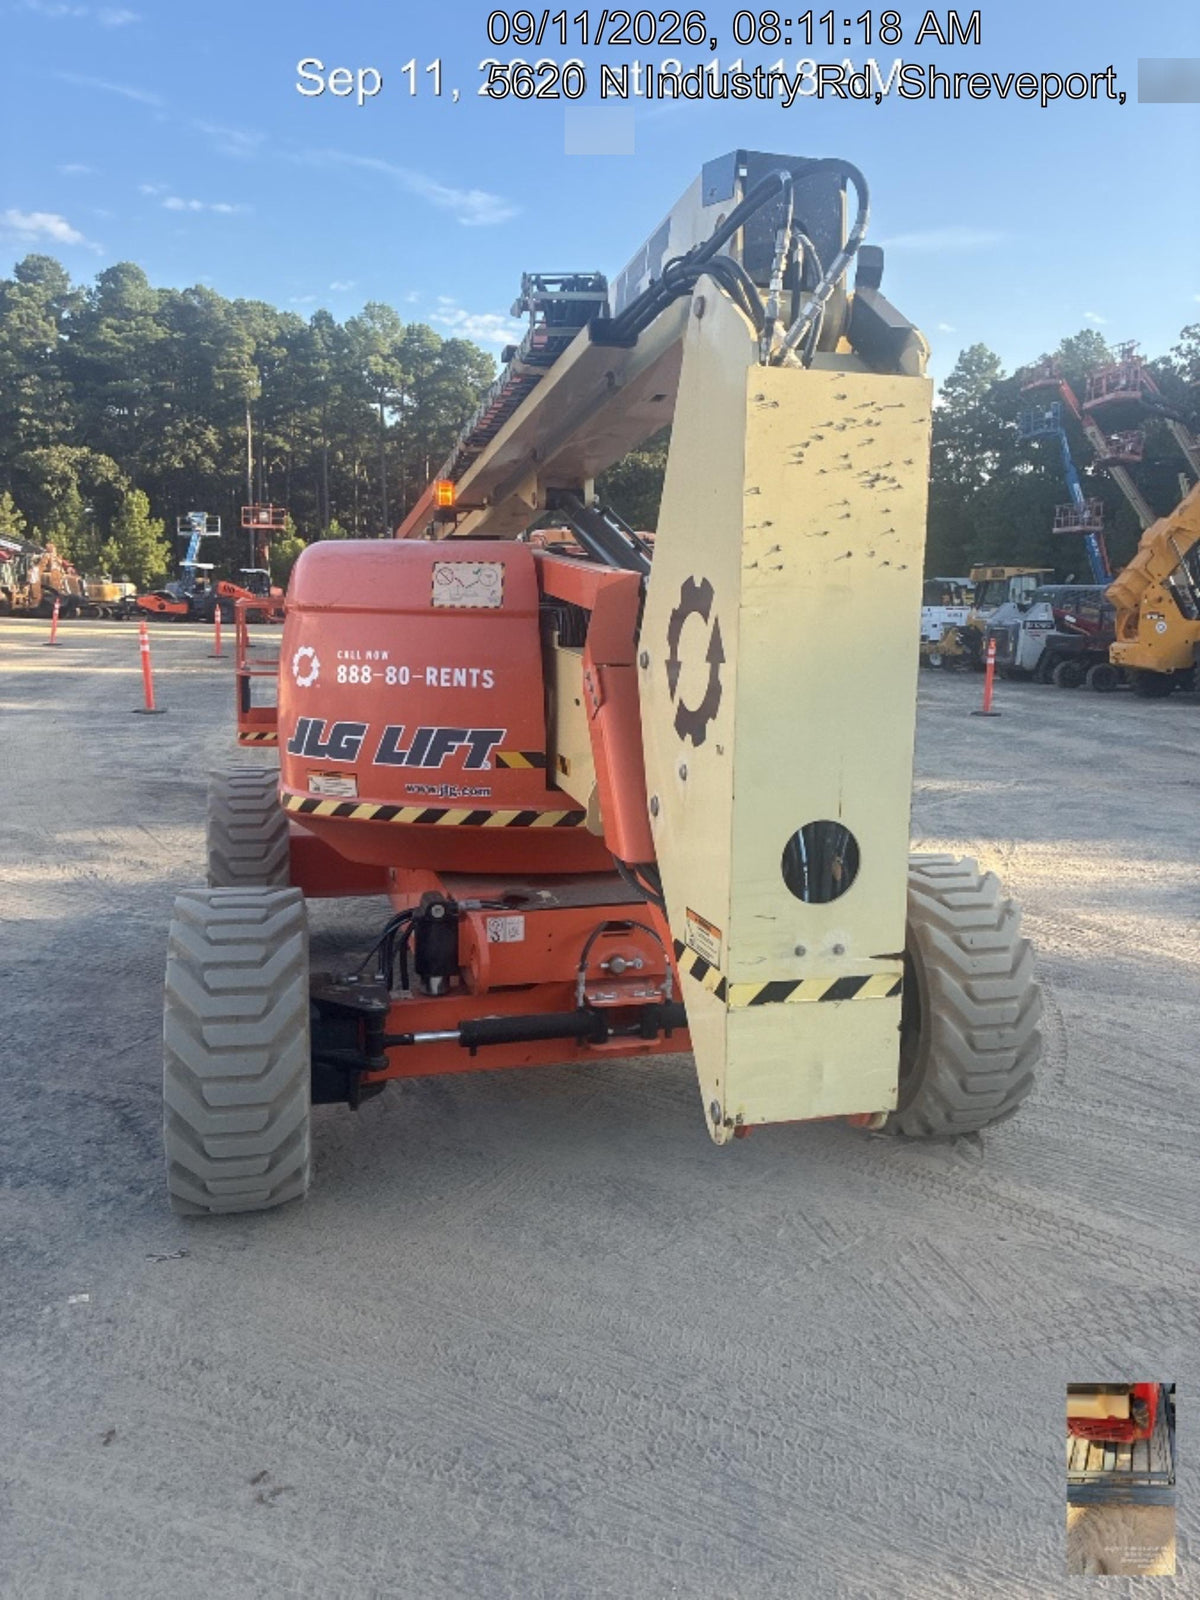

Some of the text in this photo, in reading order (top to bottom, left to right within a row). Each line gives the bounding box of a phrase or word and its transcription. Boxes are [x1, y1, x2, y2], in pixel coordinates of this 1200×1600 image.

[336, 650, 389, 661] CALL NOW
[336, 664, 495, 690] 888-80-RENTS
[287, 716, 507, 771] JLG LIFT
[404, 783, 492, 799] www.jlg.com
